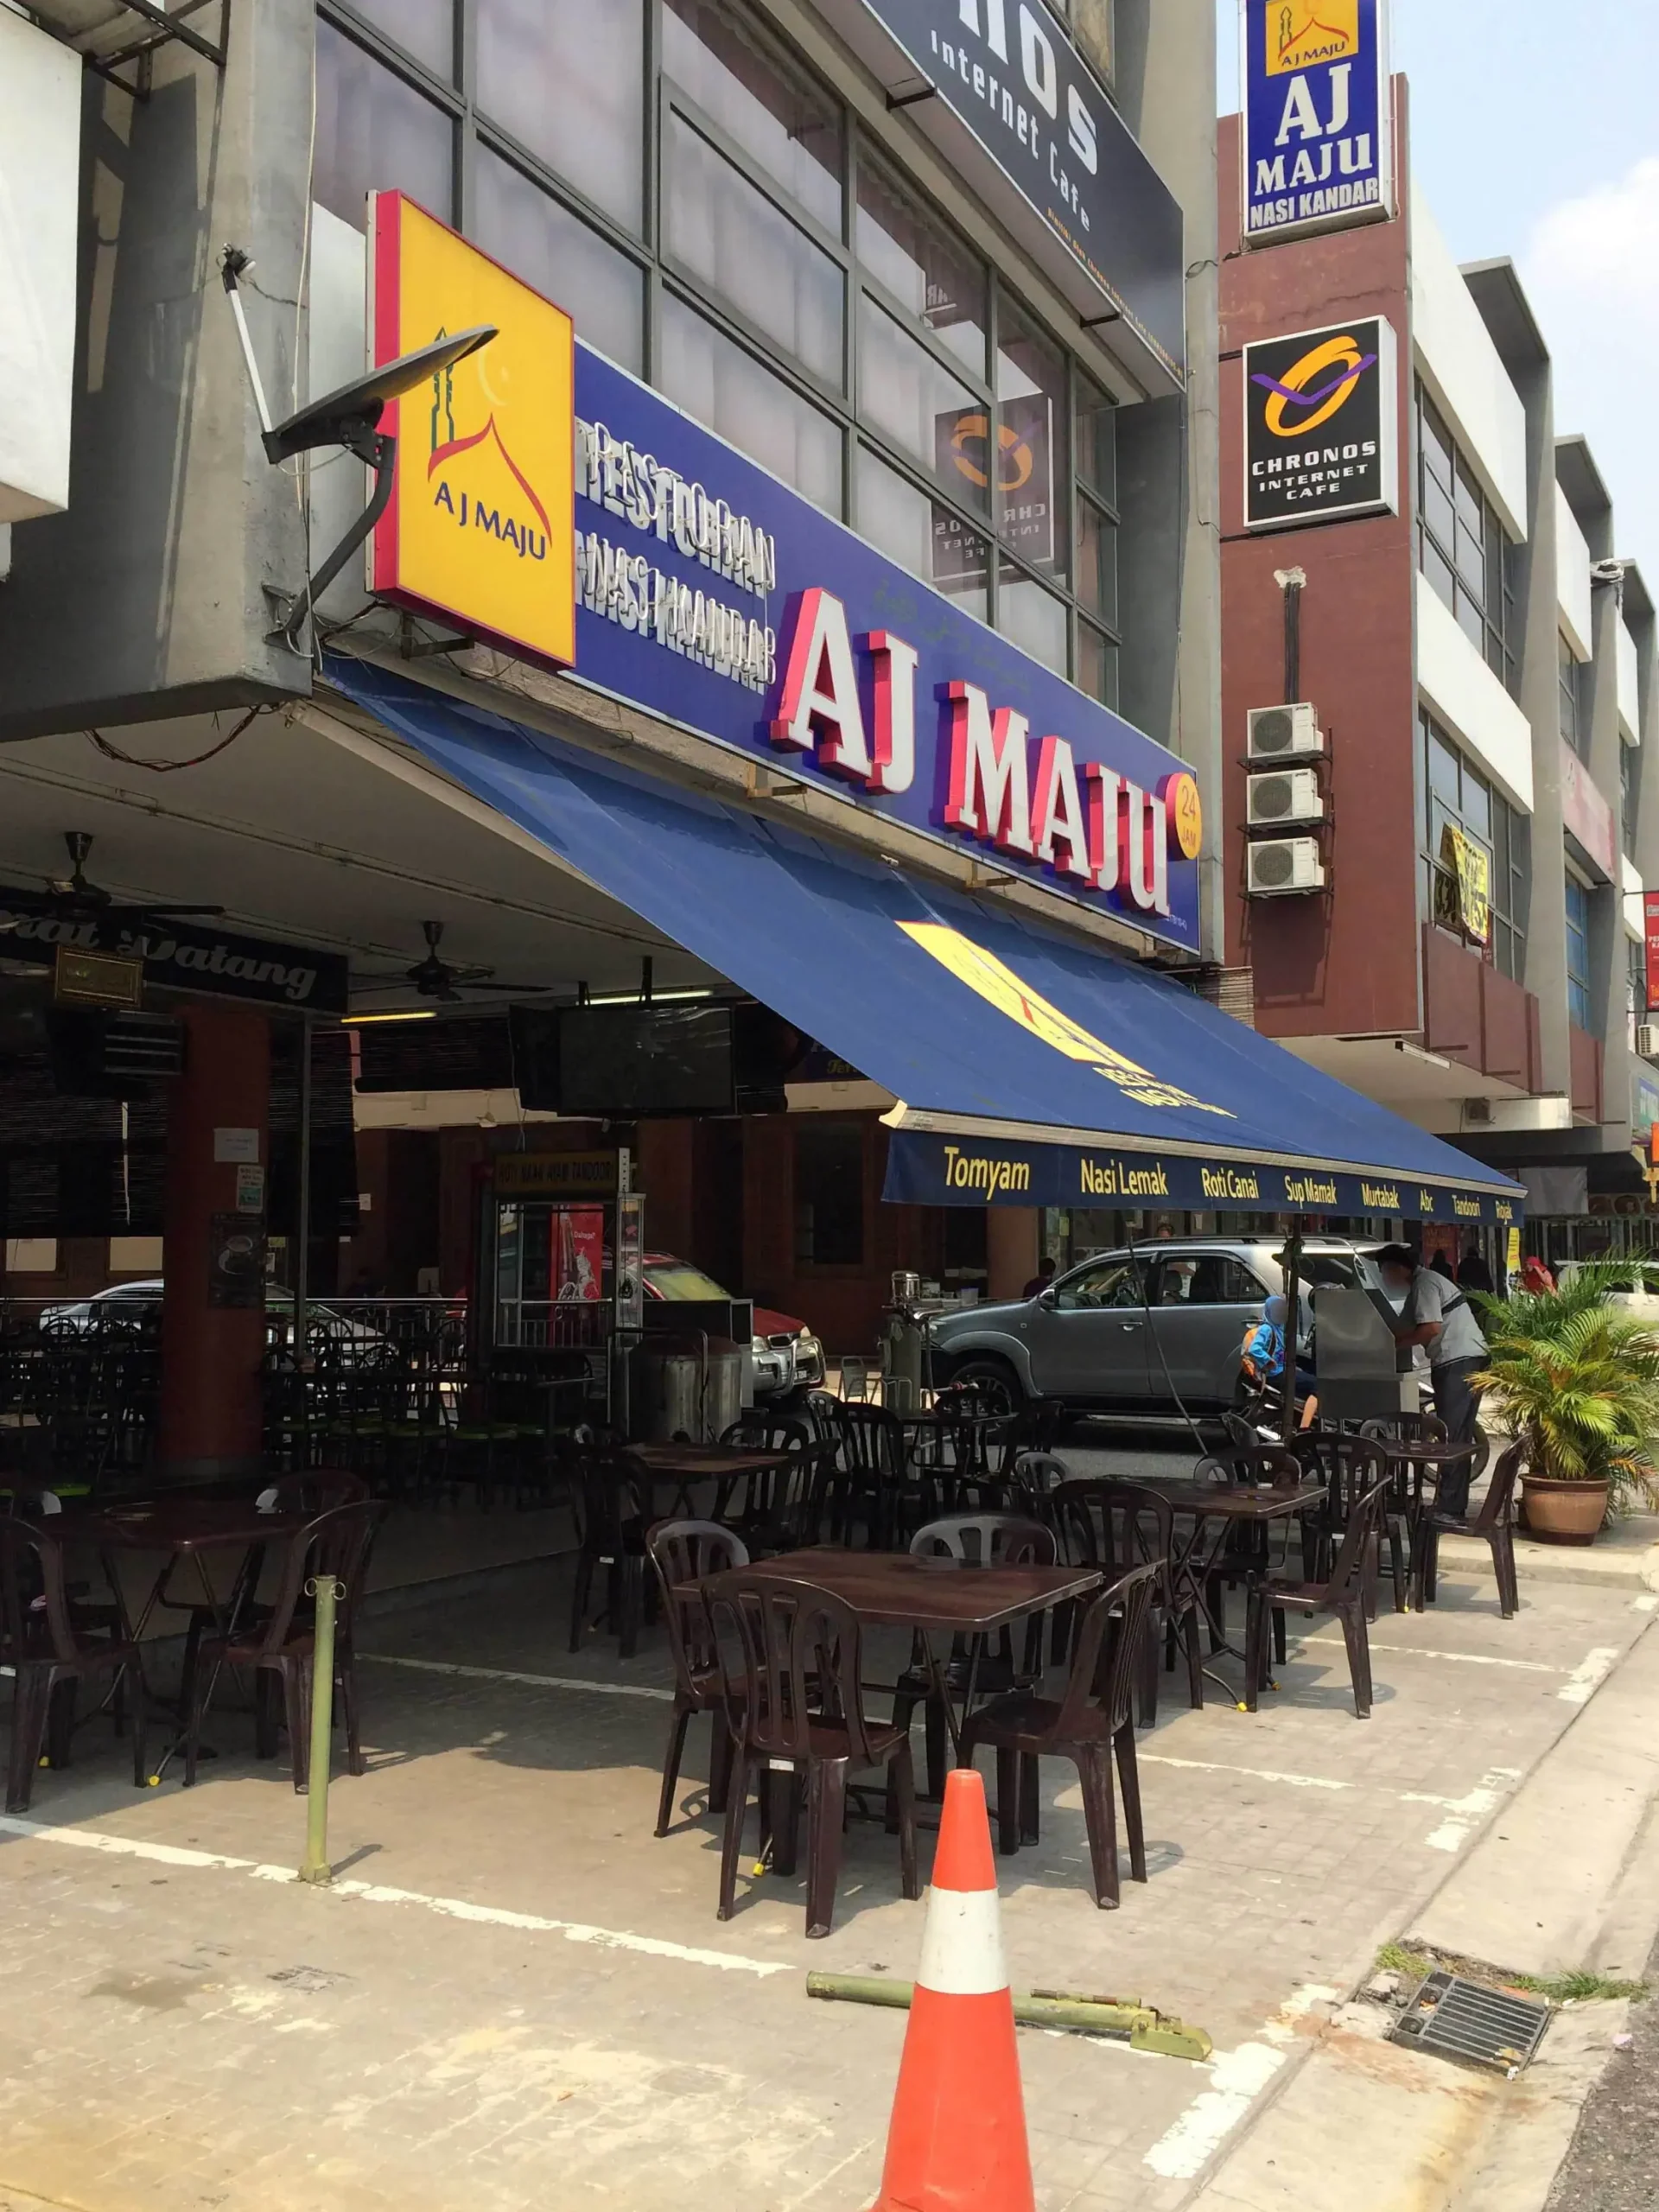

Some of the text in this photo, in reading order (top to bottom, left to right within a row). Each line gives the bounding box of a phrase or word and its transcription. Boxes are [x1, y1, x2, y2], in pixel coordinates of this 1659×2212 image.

[1303, 41, 1345, 61] MAJU
[1274, 62, 1351, 147] AJ
[931, 29, 1090, 232] Internet Cafe
[1250, 176, 1378, 229] NASI KANDAR
[1252, 441, 1376, 476] CHRONOS
[1259, 464, 1368, 492] INTERNET
[1287, 482, 1340, 500] CAFE
[475, 500, 546, 561] MAJU
[770, 588, 918, 793] AJ
[1181, 785, 1196, 823] 24
[944, 1146, 1030, 1201] Tomyam
[1081, 1158, 1169, 1196] Nasi Lemak
[1201, 1167, 1259, 1199] Roti Canai
[1284, 1174, 1338, 1210] Sup Mamak
[1361, 1182, 1401, 1210] Murtabak
[1452, 1194, 1481, 1217] Tandoori
[1495, 1199, 1513, 1225] Rojak
